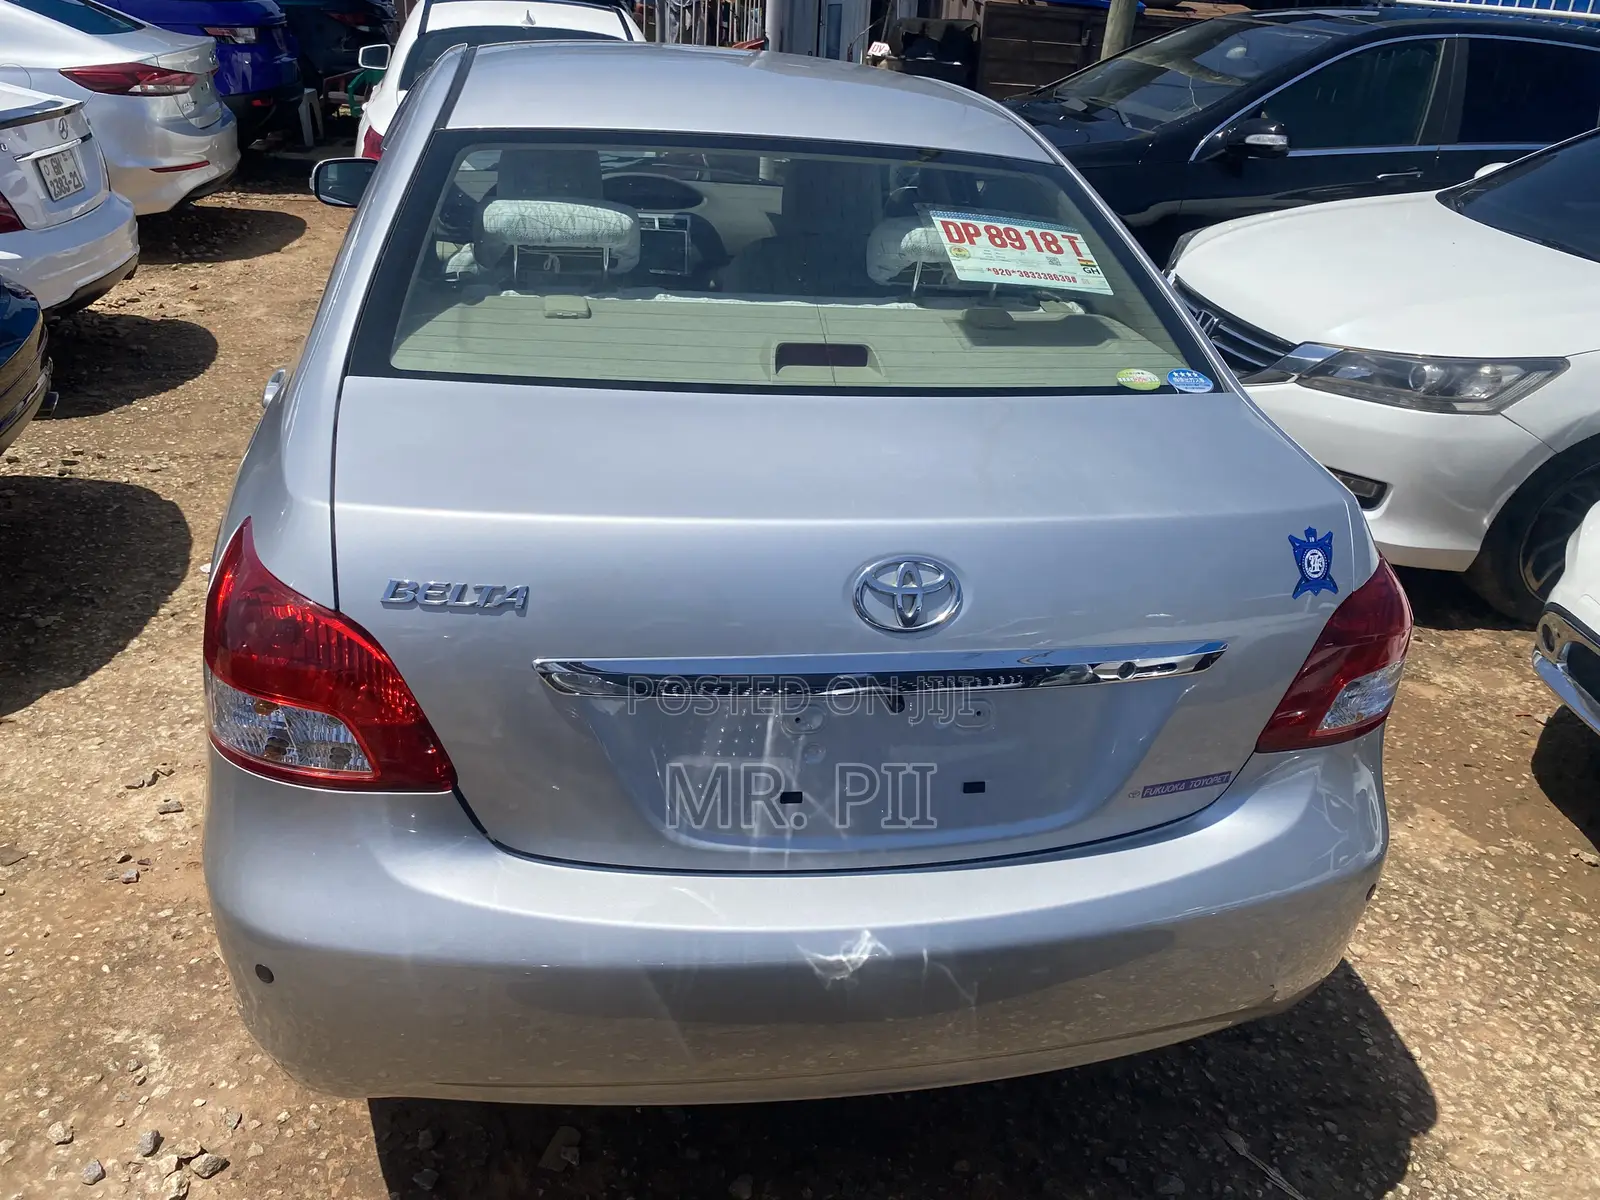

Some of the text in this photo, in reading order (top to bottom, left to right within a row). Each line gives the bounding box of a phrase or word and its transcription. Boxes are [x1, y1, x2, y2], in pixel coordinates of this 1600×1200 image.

[940, 220, 1084, 257] DP 8918 T
[1082, 267, 1101, 276] GH
[380, 577, 530, 612] BELTA
[1143, 774, 1230, 797] FUKUOKA TOYOPET
